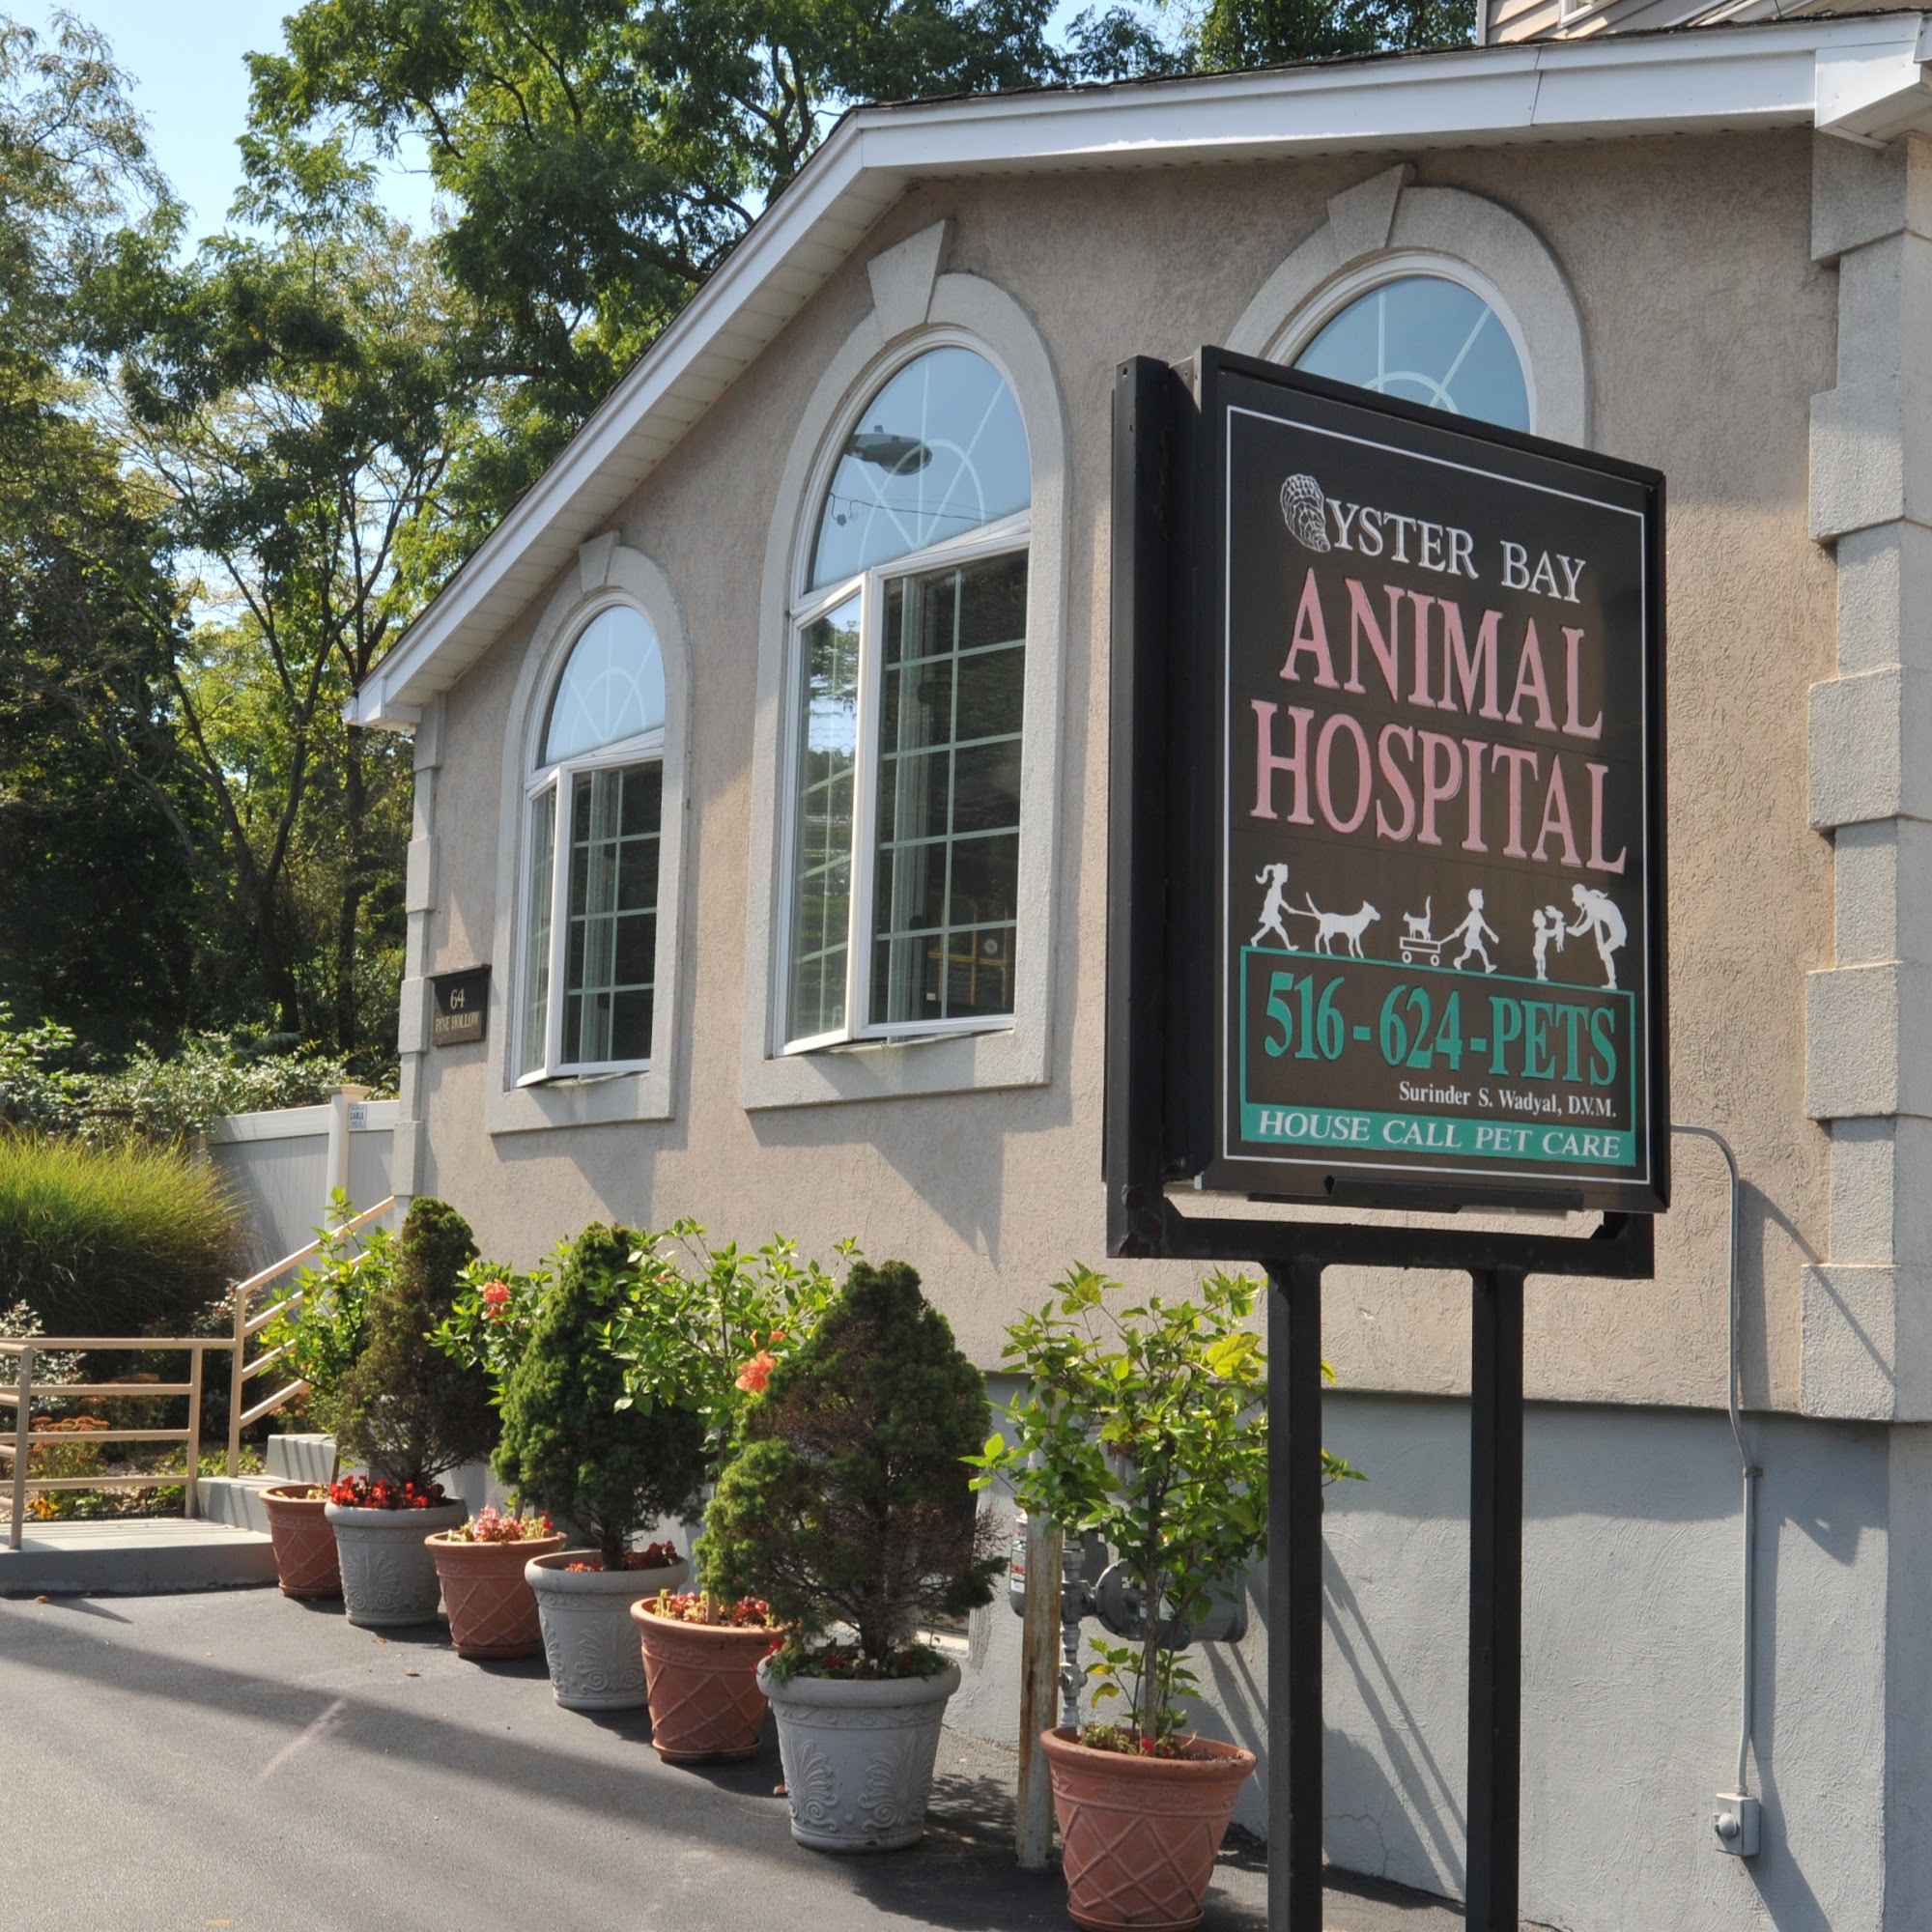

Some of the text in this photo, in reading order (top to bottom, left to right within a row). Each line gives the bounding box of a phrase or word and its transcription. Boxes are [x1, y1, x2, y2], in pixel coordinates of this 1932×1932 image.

[1500, 539, 1586, 605] BAY
[1279, 566, 1604, 741] ANIMAL
[1250, 698, 1628, 875] HOSPITAL
[449, 988, 466, 1010] 64
[451, 1010, 480, 1030] HOLLOW
[1264, 971, 1618, 1087] 516-624-PETS
[1398, 1080, 1618, 1119] Surinder S. Wadyal, D.V.M.
[1258, 1110, 1621, 1158] HOUSE CALL PET CARE
